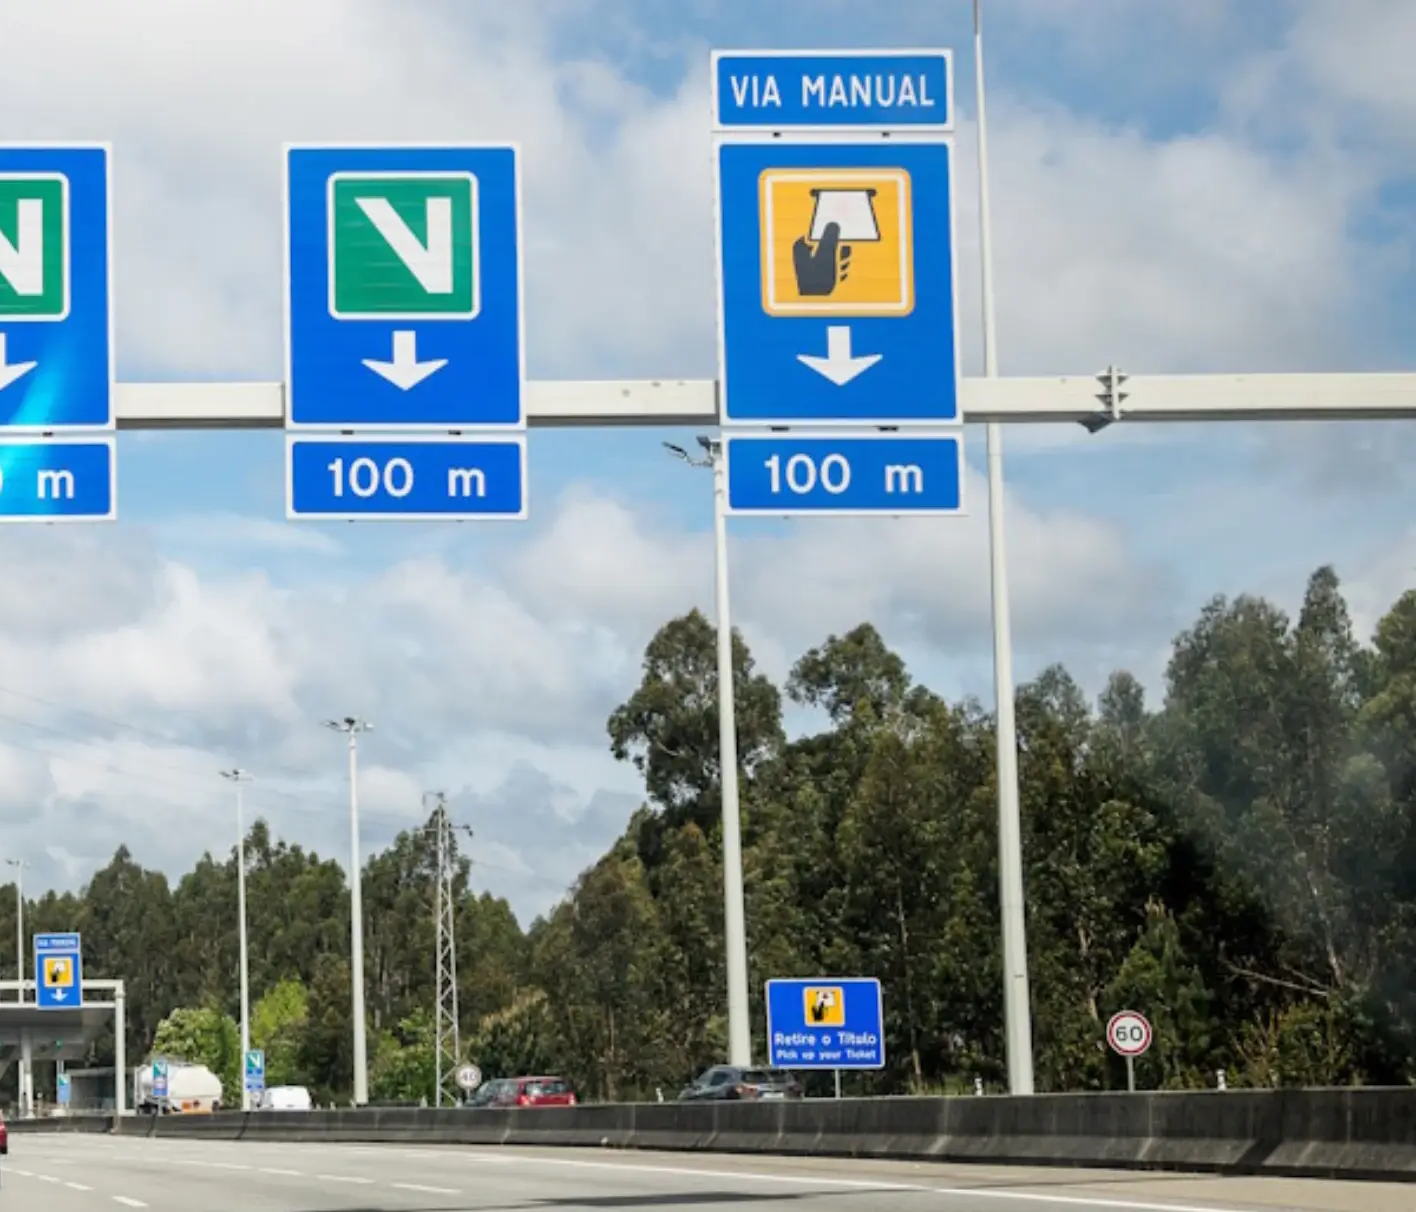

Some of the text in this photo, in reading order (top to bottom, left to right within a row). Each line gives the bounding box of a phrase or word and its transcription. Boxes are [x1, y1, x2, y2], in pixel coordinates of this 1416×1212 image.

[730, 74, 934, 107] VIA MANUAL
[37, 470, 75, 499] m
[328, 457, 486, 497] 100 m
[764, 453, 923, 494] 100 m
[774, 1032, 816, 1046] Retire
[821, 1034, 832, 1046] o
[1115, 1025, 1144, 1042] 60
[776, 1049, 877, 1061] Pick up your Ticket
